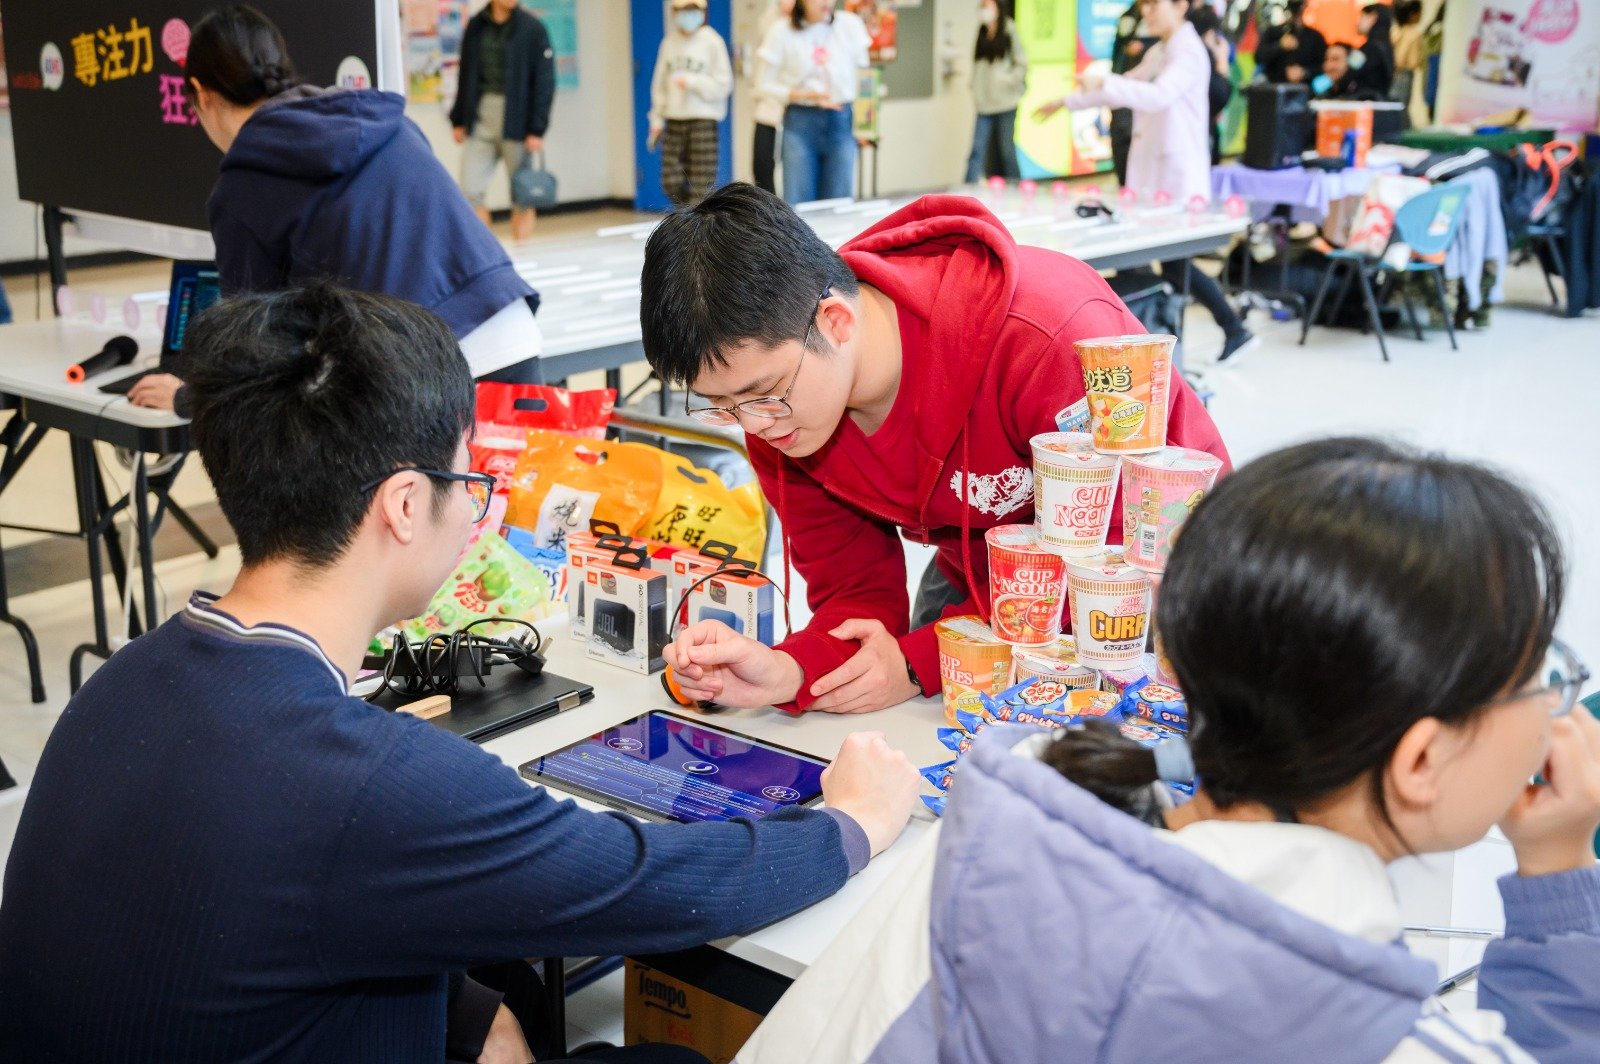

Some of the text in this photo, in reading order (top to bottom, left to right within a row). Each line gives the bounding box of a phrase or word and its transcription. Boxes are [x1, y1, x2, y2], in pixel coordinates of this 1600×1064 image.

[70, 17, 153, 87] 專注力
[160, 73, 199, 125] 狂
[682, 506, 721, 549] 旺旺
[1001, 578, 1061, 597] NOODLES
[1014, 569, 1054, 583] CUP
[597, 612, 618, 638] JBL
[1089, 609, 1147, 642] CURR
[633, 963, 687, 1009] Tempo
